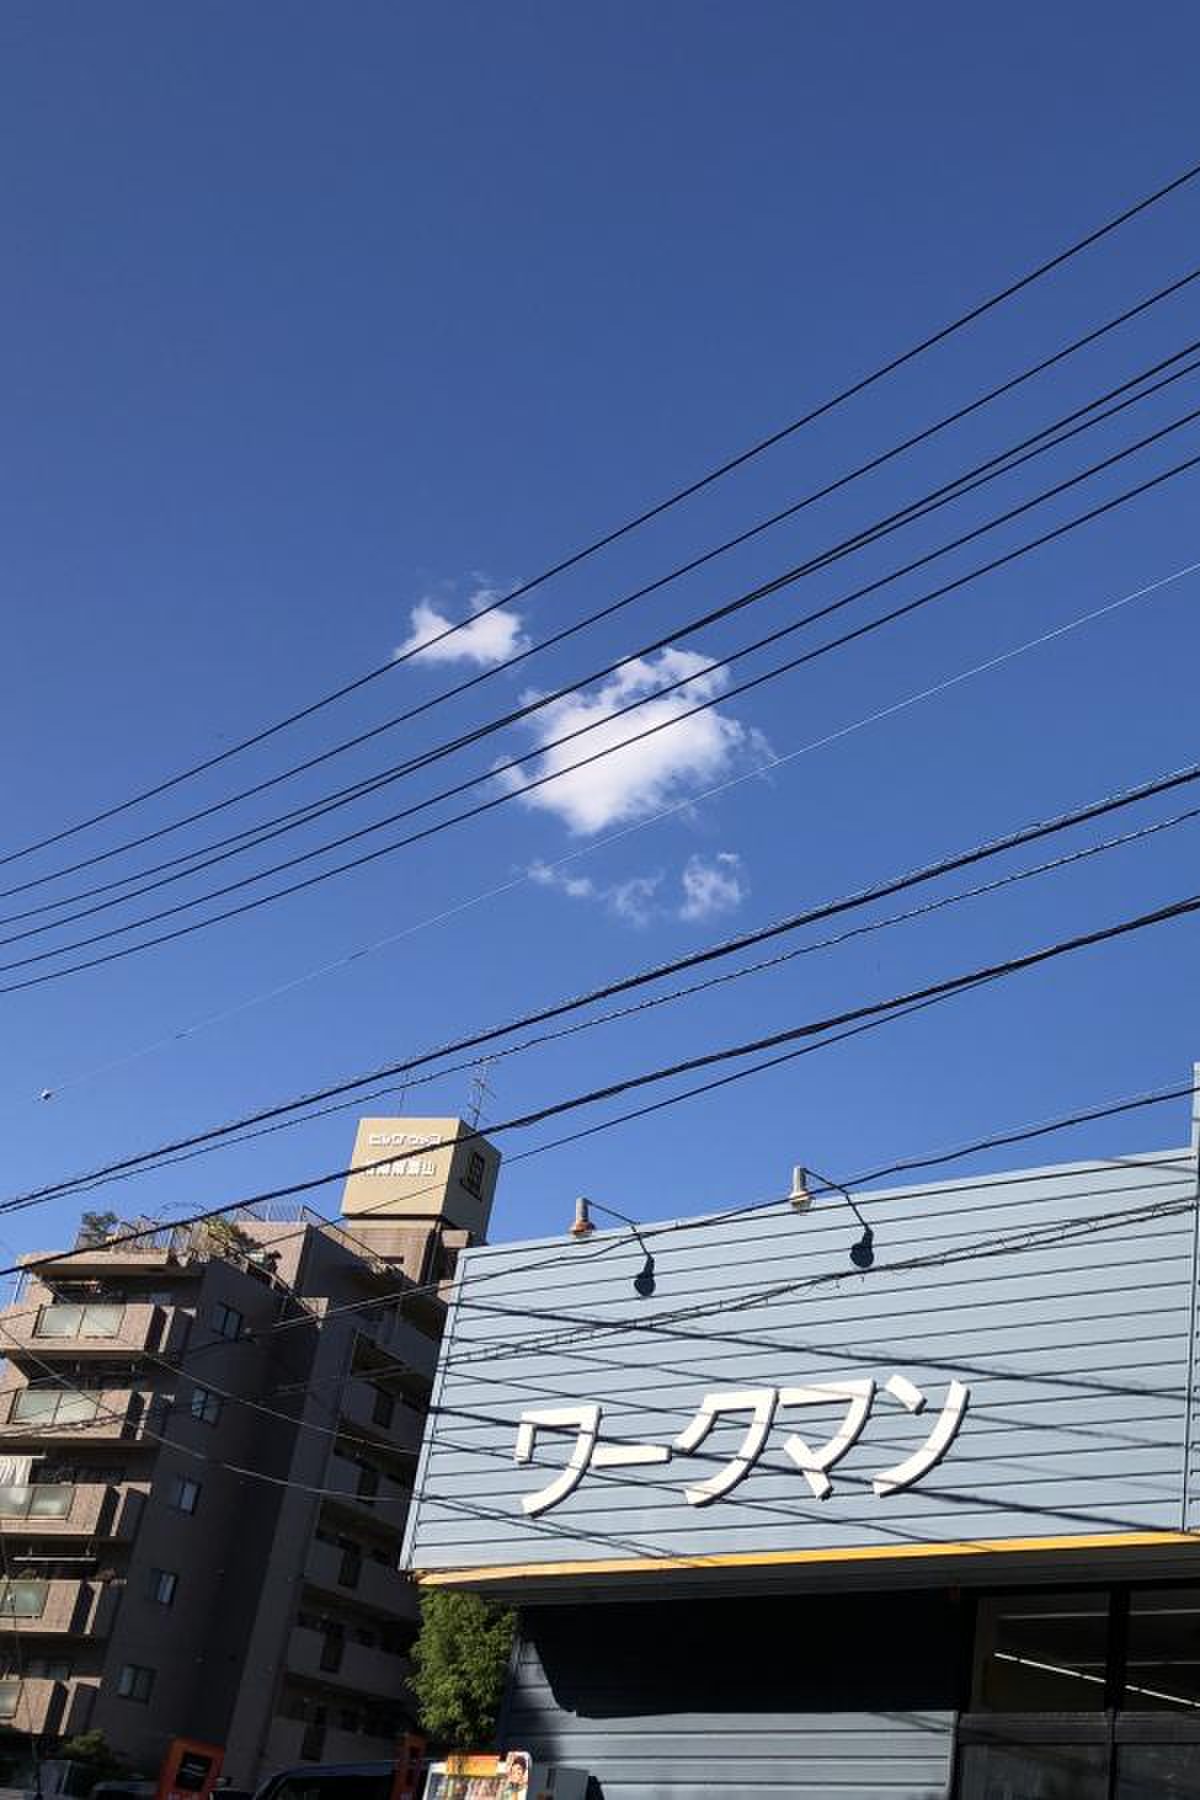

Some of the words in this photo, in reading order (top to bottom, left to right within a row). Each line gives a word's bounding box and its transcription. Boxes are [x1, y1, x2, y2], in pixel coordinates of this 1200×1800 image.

[515, 1375, 970, 1516] ワークマン
